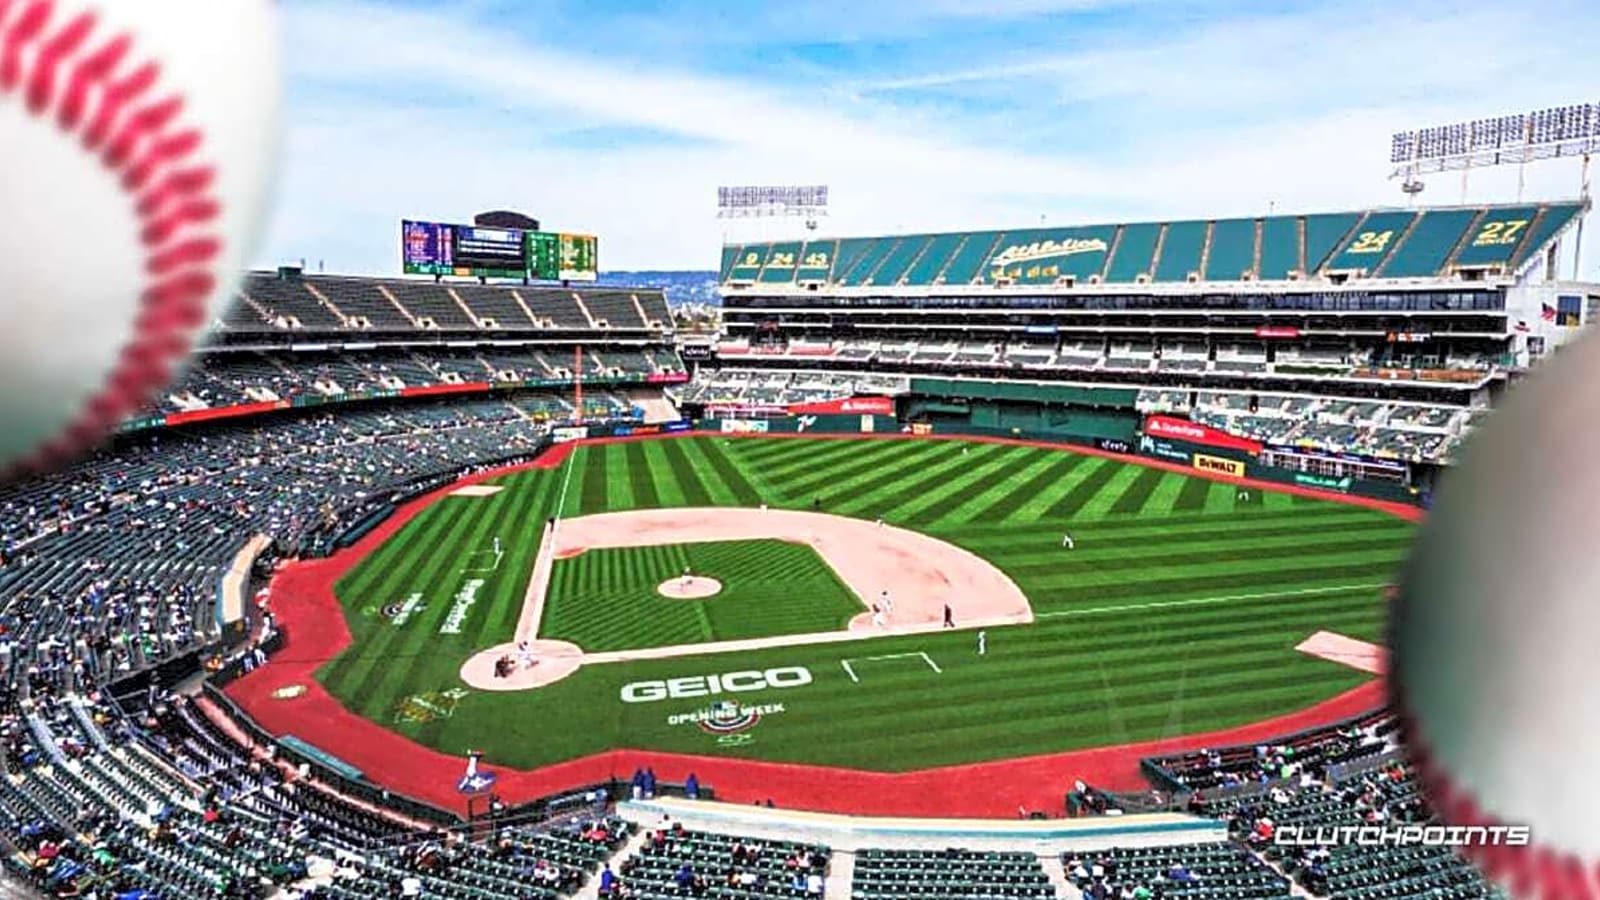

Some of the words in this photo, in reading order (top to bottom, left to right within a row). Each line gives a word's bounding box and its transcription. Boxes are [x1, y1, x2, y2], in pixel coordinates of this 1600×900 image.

[1478, 220, 1528, 239] 27
[1352, 231, 1393, 249] 34
[771, 253, 793, 265] 24
[806, 253, 827, 266] 43
[991, 238, 1107, 265] Athletics
[620, 666, 813, 703] GEICO
[668, 707, 738, 725] OPENING
[740, 702, 786, 717] WEEK
